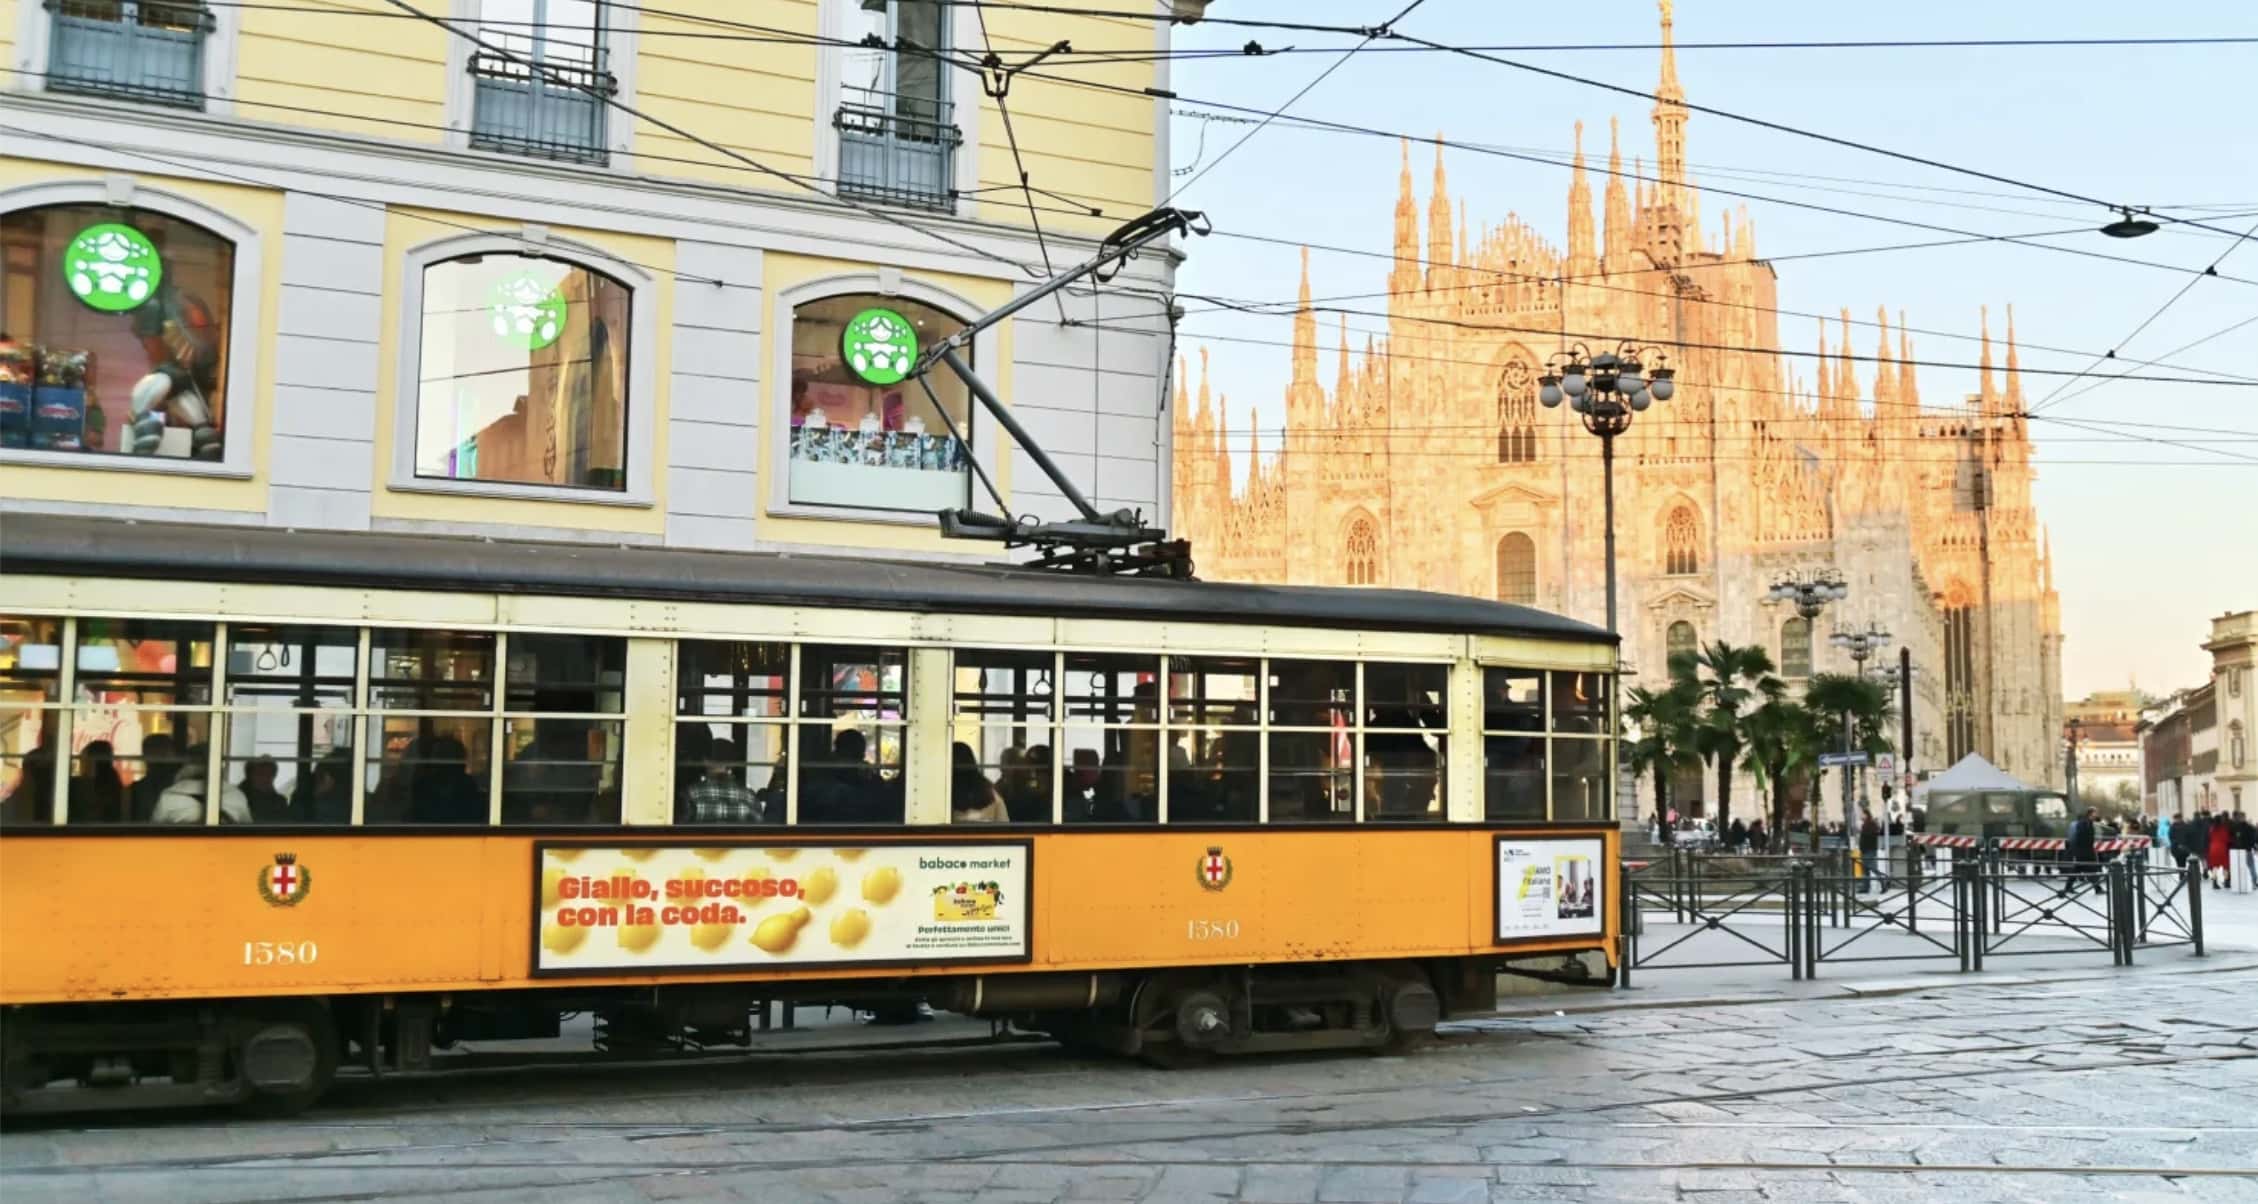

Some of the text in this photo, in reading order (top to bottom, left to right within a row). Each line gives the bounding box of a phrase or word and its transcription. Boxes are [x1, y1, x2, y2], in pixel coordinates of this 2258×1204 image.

[919, 857, 1011, 869] babaco market
[557, 876, 806, 901] Giallo, succoso,
[557, 903, 747, 927] con la coda.
[1187, 919, 1240, 941] 1580
[243, 940, 319, 965] 1580
